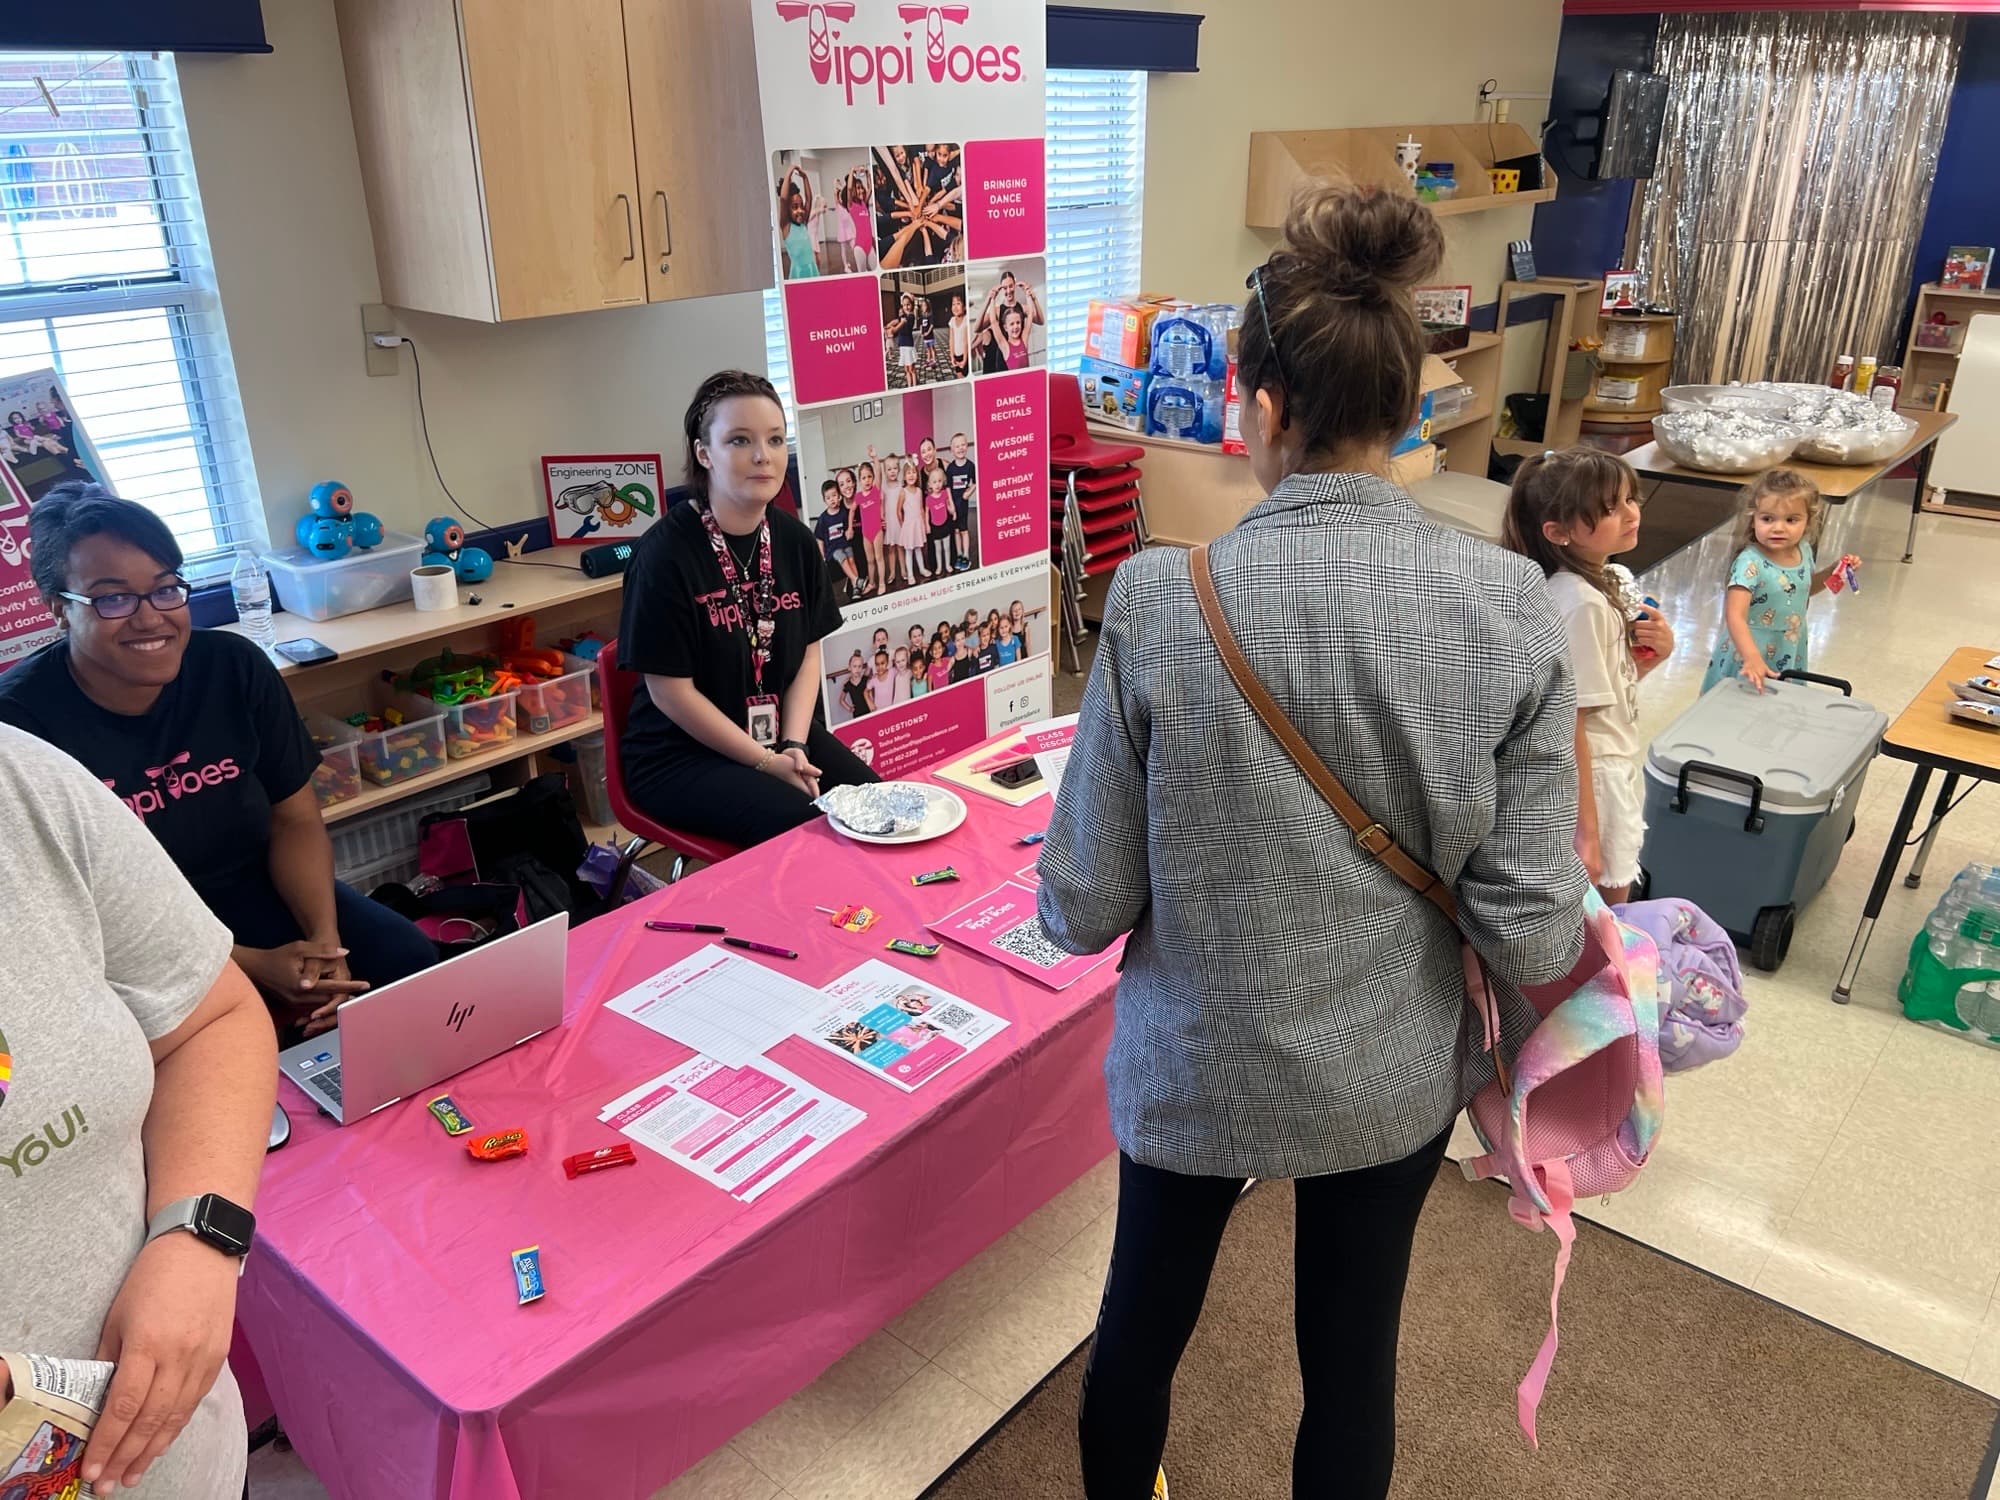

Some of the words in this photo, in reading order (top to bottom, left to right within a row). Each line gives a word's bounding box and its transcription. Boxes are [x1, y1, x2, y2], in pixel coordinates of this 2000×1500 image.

[776, 1, 914, 106] Tippi
[897, 3, 1022, 83] Toes
[983, 178, 1028, 191] BRINGING
[989, 192, 1022, 205] DANCE
[987, 209, 1000, 219] TO
[1003, 207, 1025, 219] YOU!
[809, 324, 868, 342] ENROLLING
[825, 342, 855, 355] NOW!
[996, 394, 1027, 408] DANCE
[991, 407, 1033, 423] RECITALS
[989, 433, 1035, 450] AWESOME
[997, 448, 1028, 462] CAMPS
[550, 467, 611, 479] Engineering
[615, 463, 656, 476] ZONE
[992, 472, 1034, 490] BIRTHDAY
[996, 486, 1031, 502] PARTIES
[996, 512, 1032, 528] SPECIAL
[998, 525, 1031, 540] EVENTS
[851, 611, 868, 621] OUT
[871, 604, 889, 615] OUR
[891, 595, 928, 609] ORIGINAL
[930, 585, 954, 597] MUSIC
[956, 572, 998, 591] STREAMING
[1000, 558, 1049, 578] EVERYWHERE
[14, 611, 54, 629] dance
[878, 713, 929, 737] QUESTIONS?
[1036, 730, 1064, 742] CLASS
[1040, 736, 1074, 749] DESCRIP
[144, 751, 240, 799] Toes
[446, 1001, 475, 1032] hp
[617, 1103, 642, 1120] CLASS
[621, 1091, 672, 1124] DESCRIPTIONS
